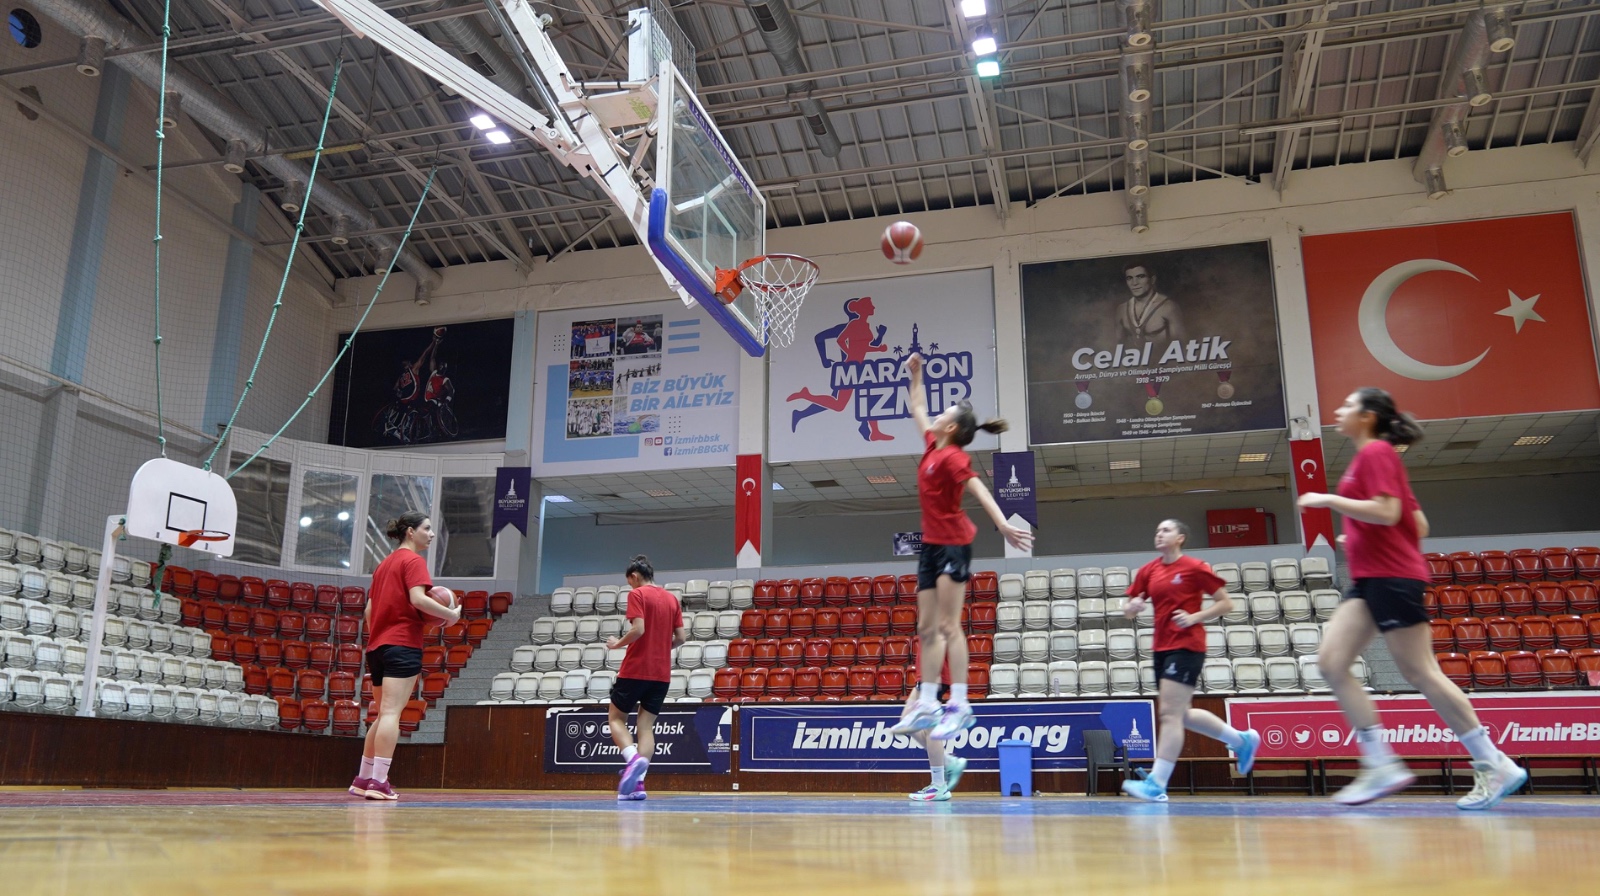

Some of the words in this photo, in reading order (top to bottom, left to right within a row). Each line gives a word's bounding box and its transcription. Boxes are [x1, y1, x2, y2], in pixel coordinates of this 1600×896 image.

[1071, 341, 1154, 371] Celal
[1158, 335, 1232, 364] Atik
[834, 355, 969, 387] MARAON
[1074, 373, 1098, 381] Avrupa,
[1099, 370, 1118, 380] Dünya
[1128, 368, 1158, 377] Olimpiyat
[1158, 365, 1193, 374] Şampiyonu
[1193, 363, 1208, 371] Milli
[1208, 361, 1232, 370] Güreşçi
[1135, 376, 1149, 384] 1918
[1155, 375, 1170, 383] 1979
[630, 377, 661, 395] BİZ
[662, 372, 727, 393] BÜYÜK
[629, 394, 661, 412] BİR
[662, 389, 735, 410] AİLEYİZ
[673, 443, 730, 456] izmirBBGSK
[674, 433, 721, 445] izmirbbsk
[791, 721, 1071, 753] izmirbspororg
[1343, 722, 1461, 746] /mirbbs
[590, 742, 674, 757] /izmSK
